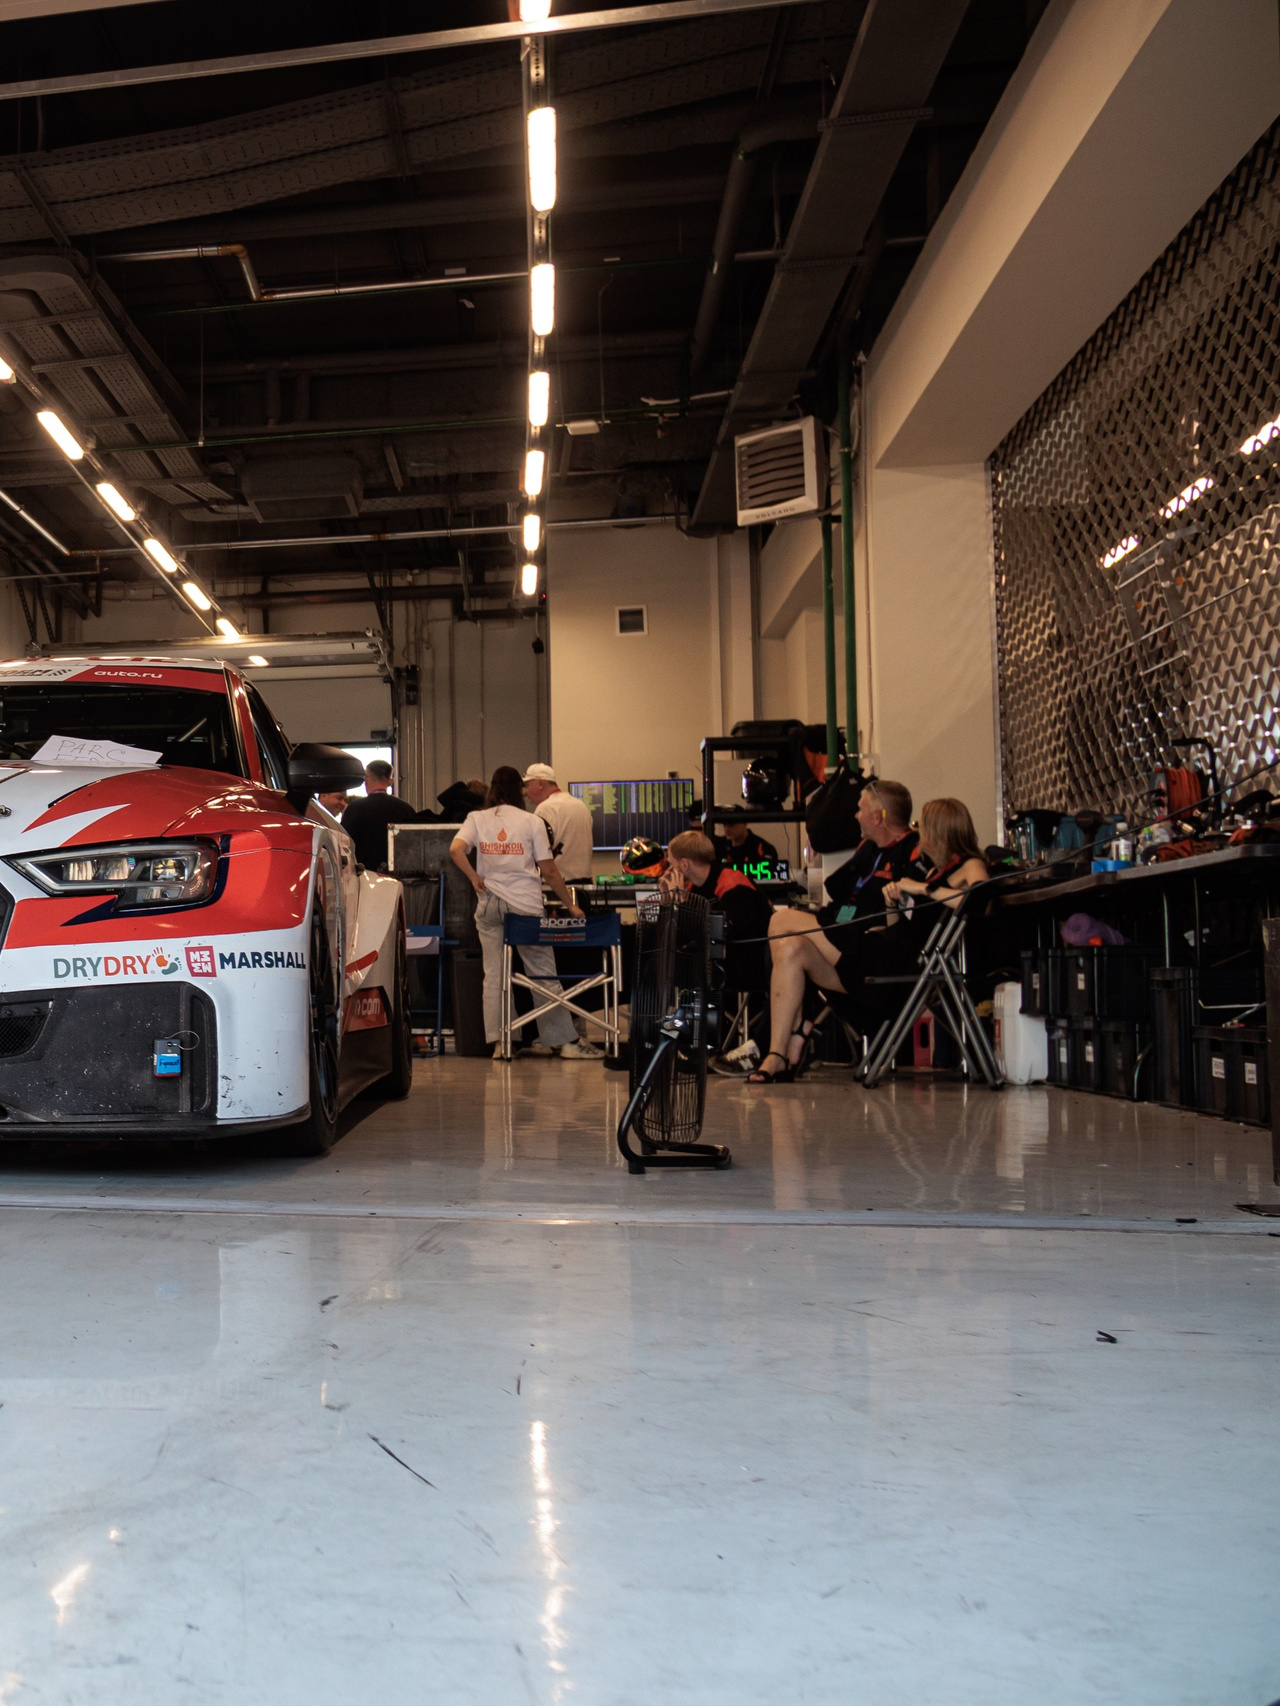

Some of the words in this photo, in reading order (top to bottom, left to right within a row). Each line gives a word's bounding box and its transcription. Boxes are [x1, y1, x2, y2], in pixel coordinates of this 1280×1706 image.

[755, 507, 795, 519] VOLCANO
[94, 670, 163, 679] auto.ru
[58, 740, 126, 762] PARC
[479, 842, 524, 850] SHISHKOIL
[53, 955, 151, 979] DRYDRY
[219, 951, 307, 970] MARSHALL
